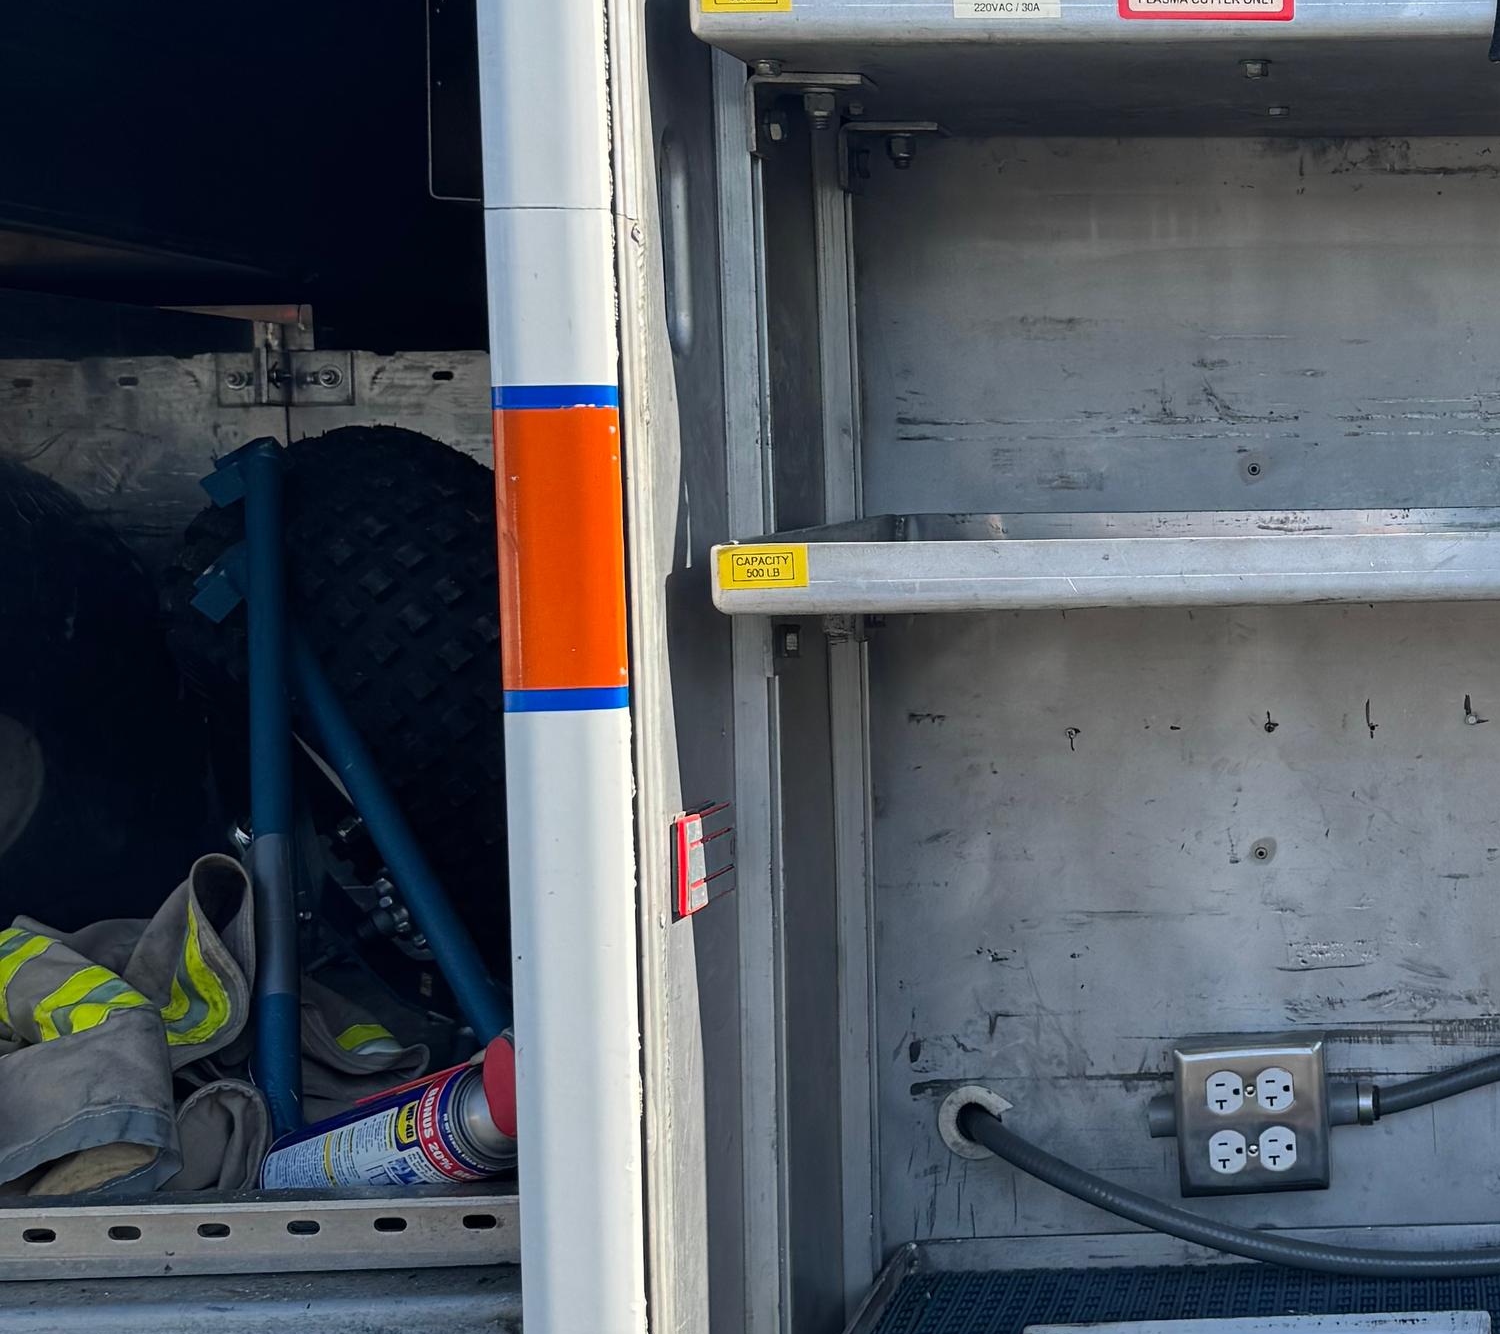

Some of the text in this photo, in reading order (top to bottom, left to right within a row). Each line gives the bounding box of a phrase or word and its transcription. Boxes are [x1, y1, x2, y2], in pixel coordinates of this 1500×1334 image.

[973, 2, 1014, 13] 220VAC
[1021, 2, 1041, 13] 30A
[736, 555, 789, 567] CAPACITY
[746, 567, 780, 578] 500 LB
[405, 1102, 418, 1140] WD-40
[422, 1087, 440, 1139] BONUS
[428, 1141, 453, 1170] 20%
